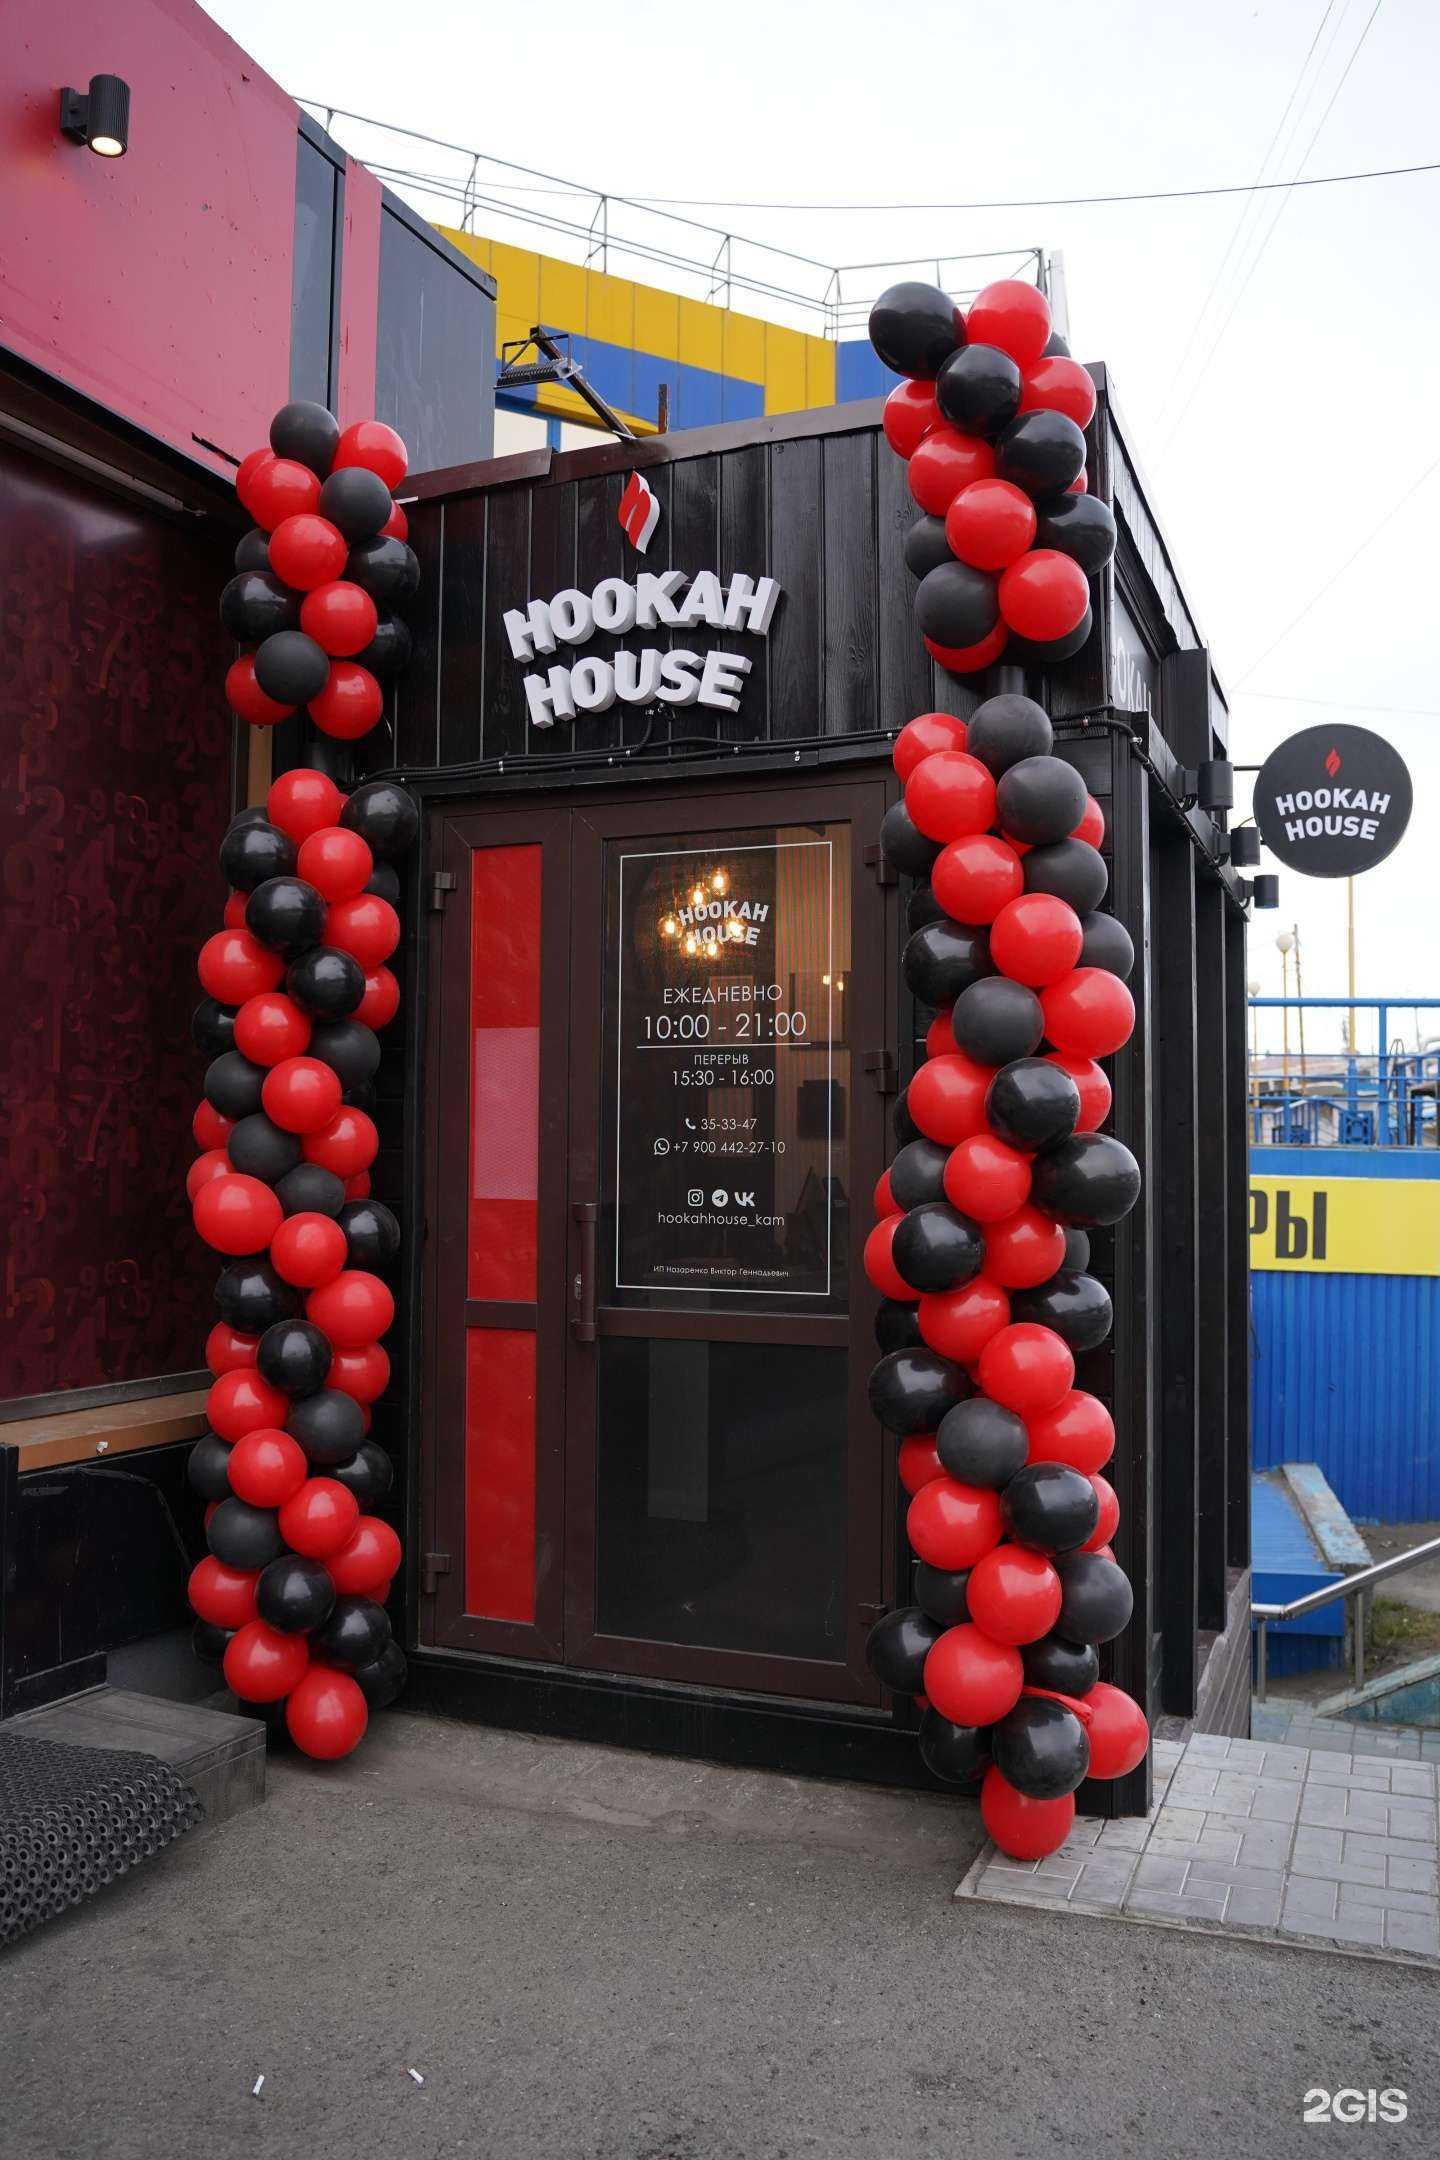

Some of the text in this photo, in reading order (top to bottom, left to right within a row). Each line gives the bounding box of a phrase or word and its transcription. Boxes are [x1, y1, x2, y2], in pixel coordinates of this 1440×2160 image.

[502, 570, 782, 664] HOOKAH
[523, 648, 753, 729] HOUSE
[1275, 787, 1391, 816] HOOKAH
[1284, 815, 1380, 842] HOUSE
[678, 900, 769, 926] HOOKAH
[663, 984, 783, 1005] ЕЖЕДНЕВНО
[644, 1014, 710, 1040] 10:00
[735, 1011, 807, 1038] 21:00
[694, 1054, 749, 1065] ПЕРЕРЫВ
[672, 1070, 714, 1086] 15:30
[731, 1069, 775, 1085] 16:00
[701, 1118, 758, 1130] 35-33-47
[673, 1141, 786, 1154] +7 900 442-27-10
[658, 1212, 785, 1227] hookahhouse_kam
[653, 1265, 665, 1273] ИП
[666, 1265, 709, 1275] Назаренко
[710, 1267, 737, 1276] Виктор
